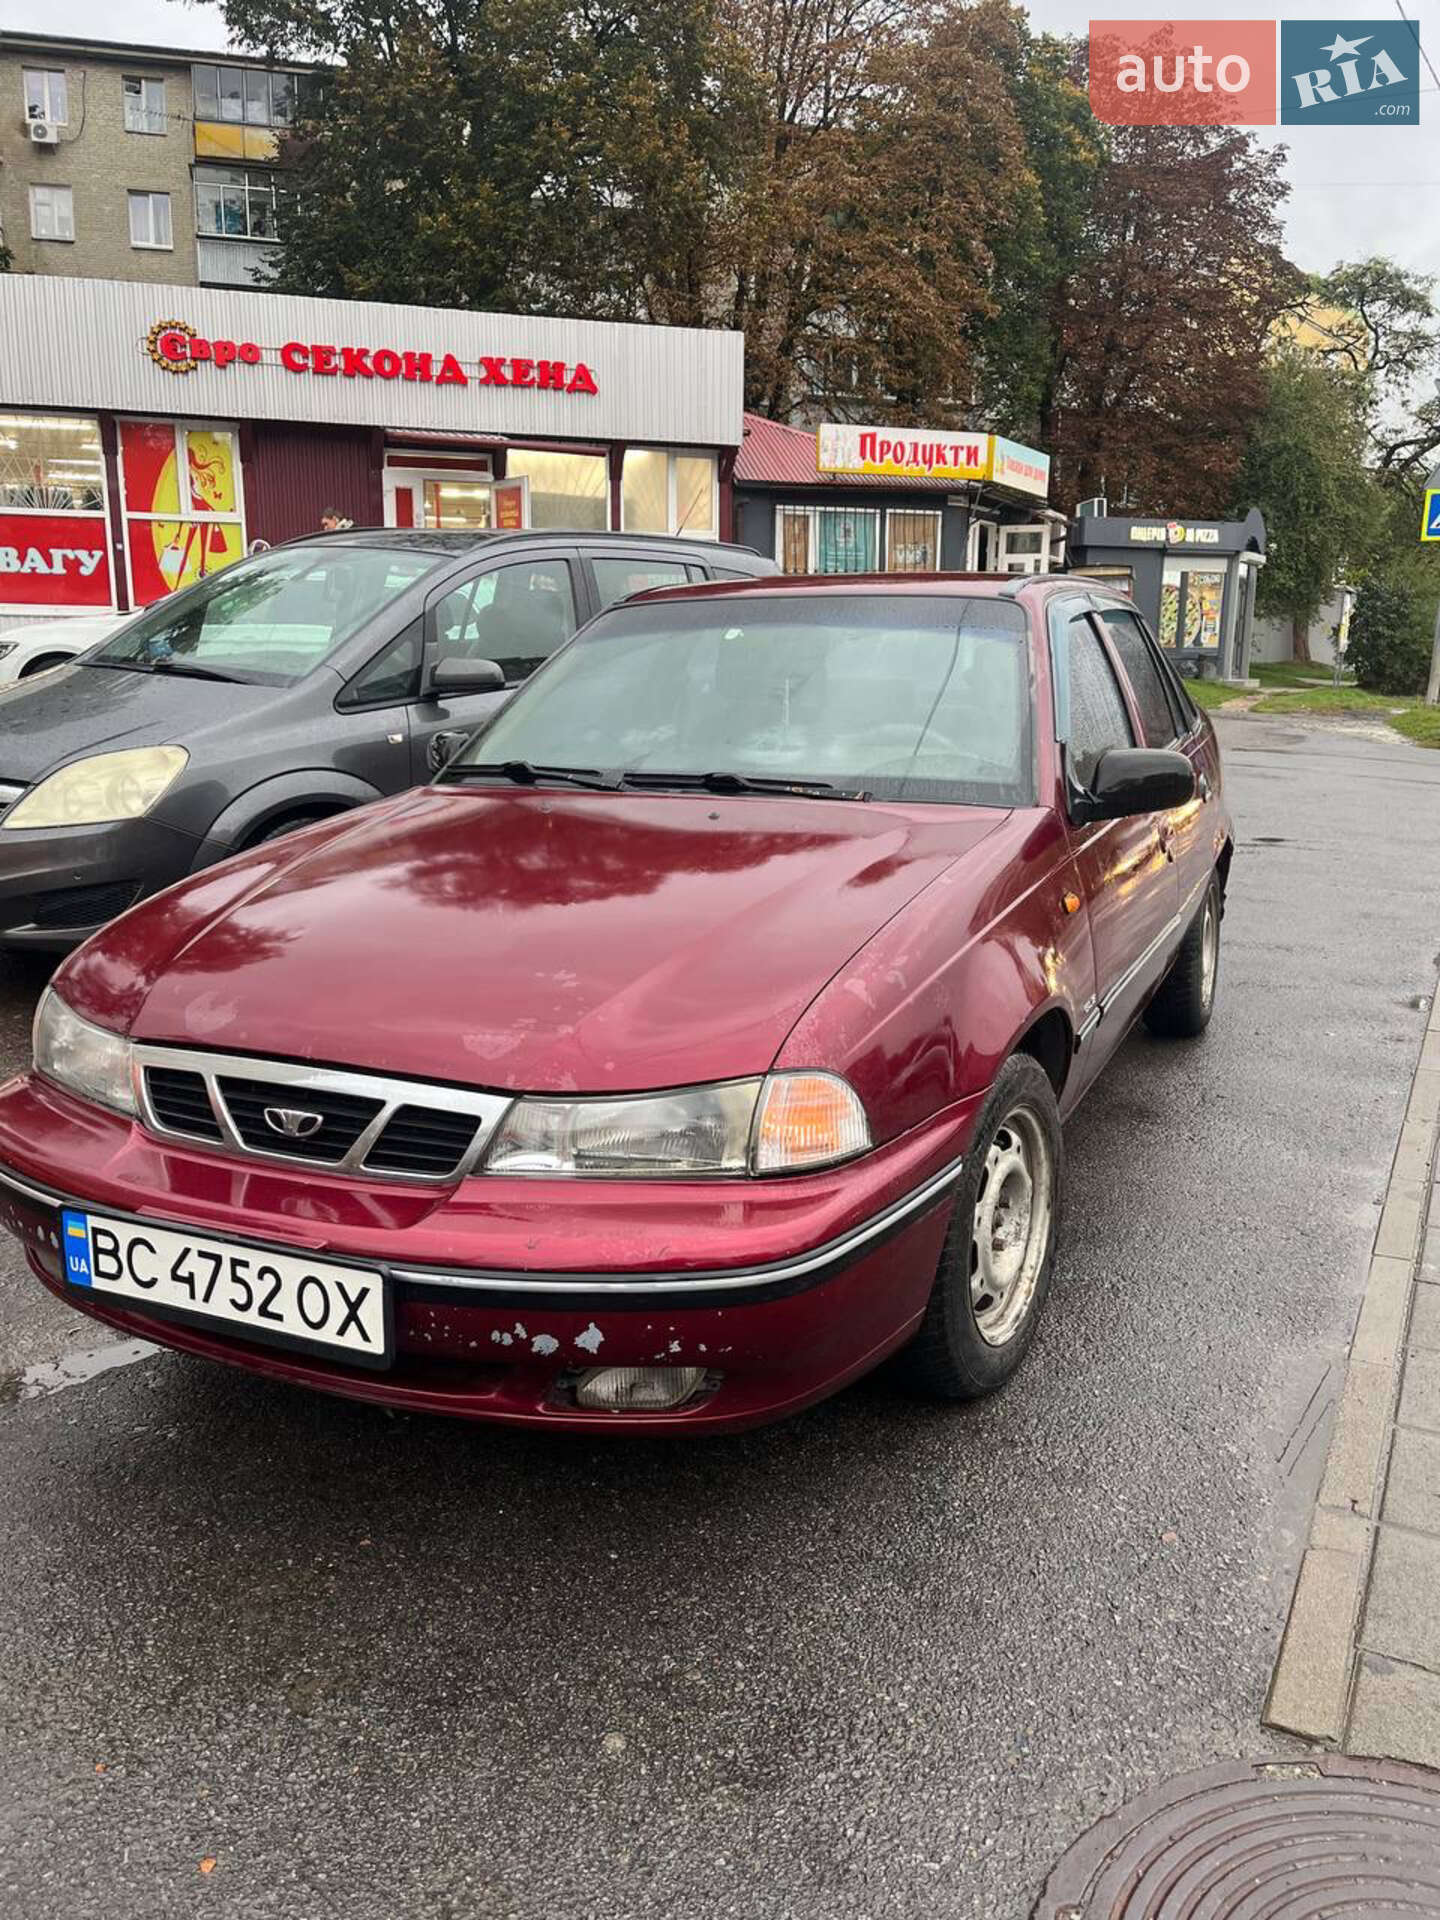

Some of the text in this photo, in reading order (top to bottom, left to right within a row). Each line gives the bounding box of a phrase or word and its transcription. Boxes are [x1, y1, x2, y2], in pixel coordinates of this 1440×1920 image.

[281, 342, 468, 385] СЕКОНД
[479, 356, 598, 395] ХЕНД
[859, 431, 980, 471] Продукти
[0, 546, 104, 576] ВАГУ
[70, 1255, 90, 1275] UA
[91, 1226, 371, 1343] BC 4752 OX
